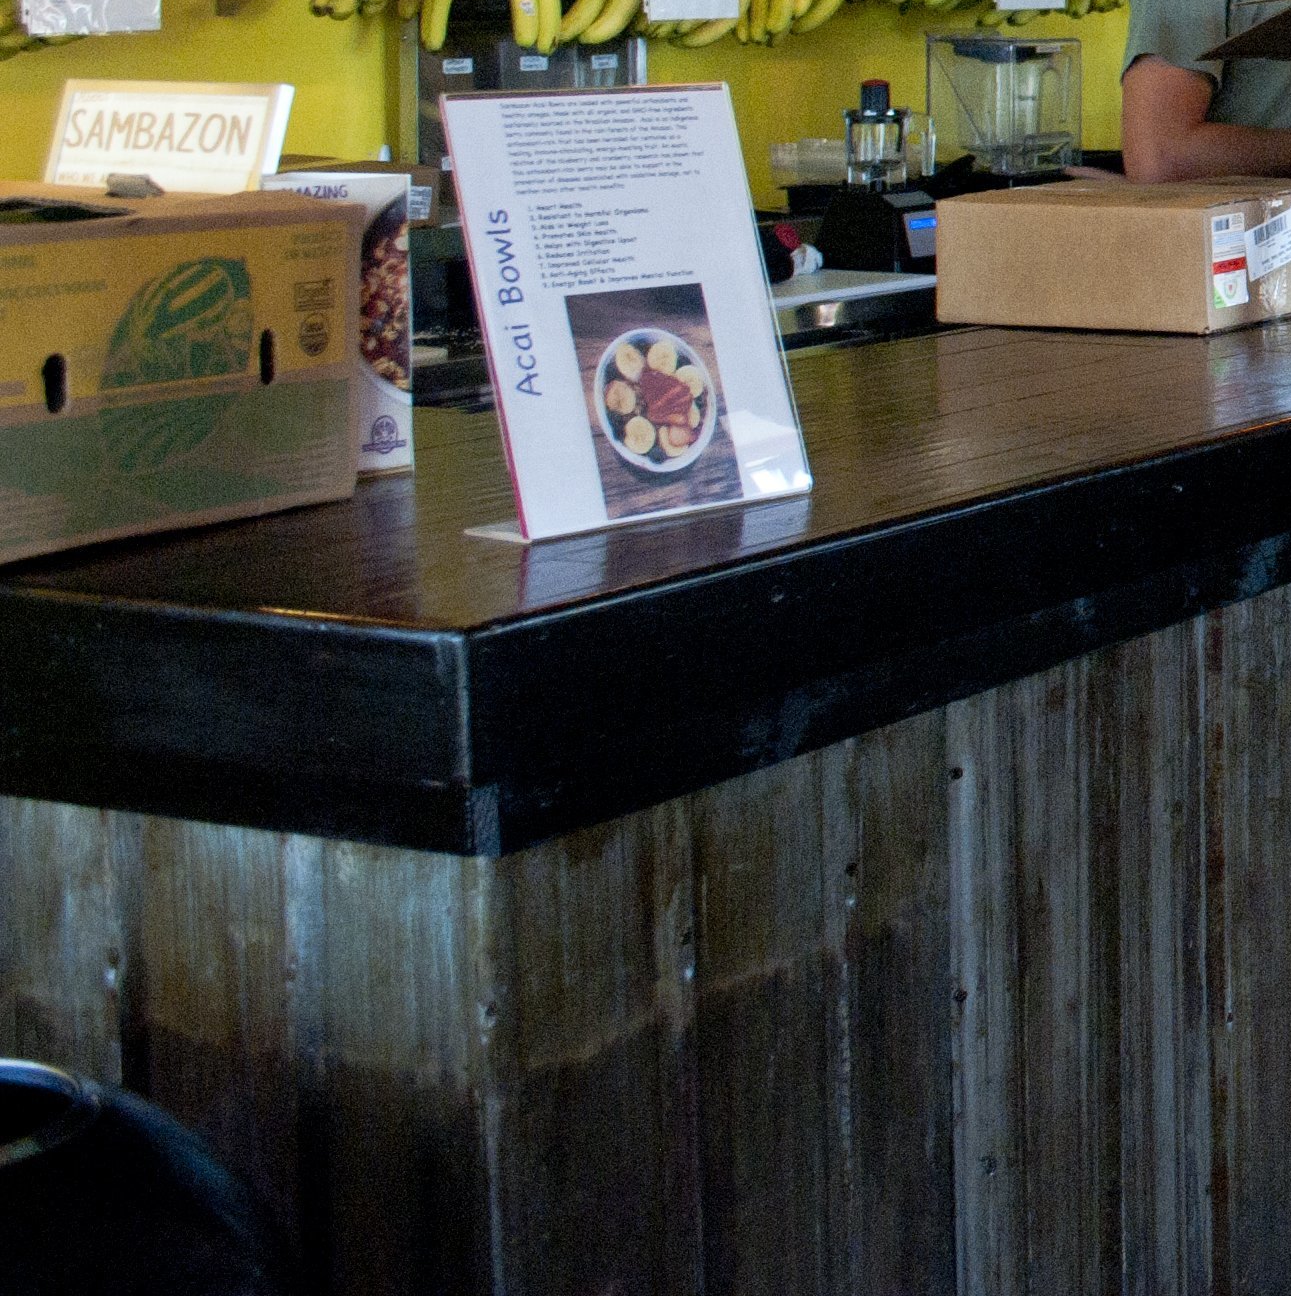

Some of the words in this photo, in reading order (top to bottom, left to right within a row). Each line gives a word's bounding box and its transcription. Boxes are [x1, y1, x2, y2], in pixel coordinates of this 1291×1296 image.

[63, 108, 253, 157] SAMBAZON
[487, 208, 525, 307] Bowls
[504, 324, 543, 397] Acai
